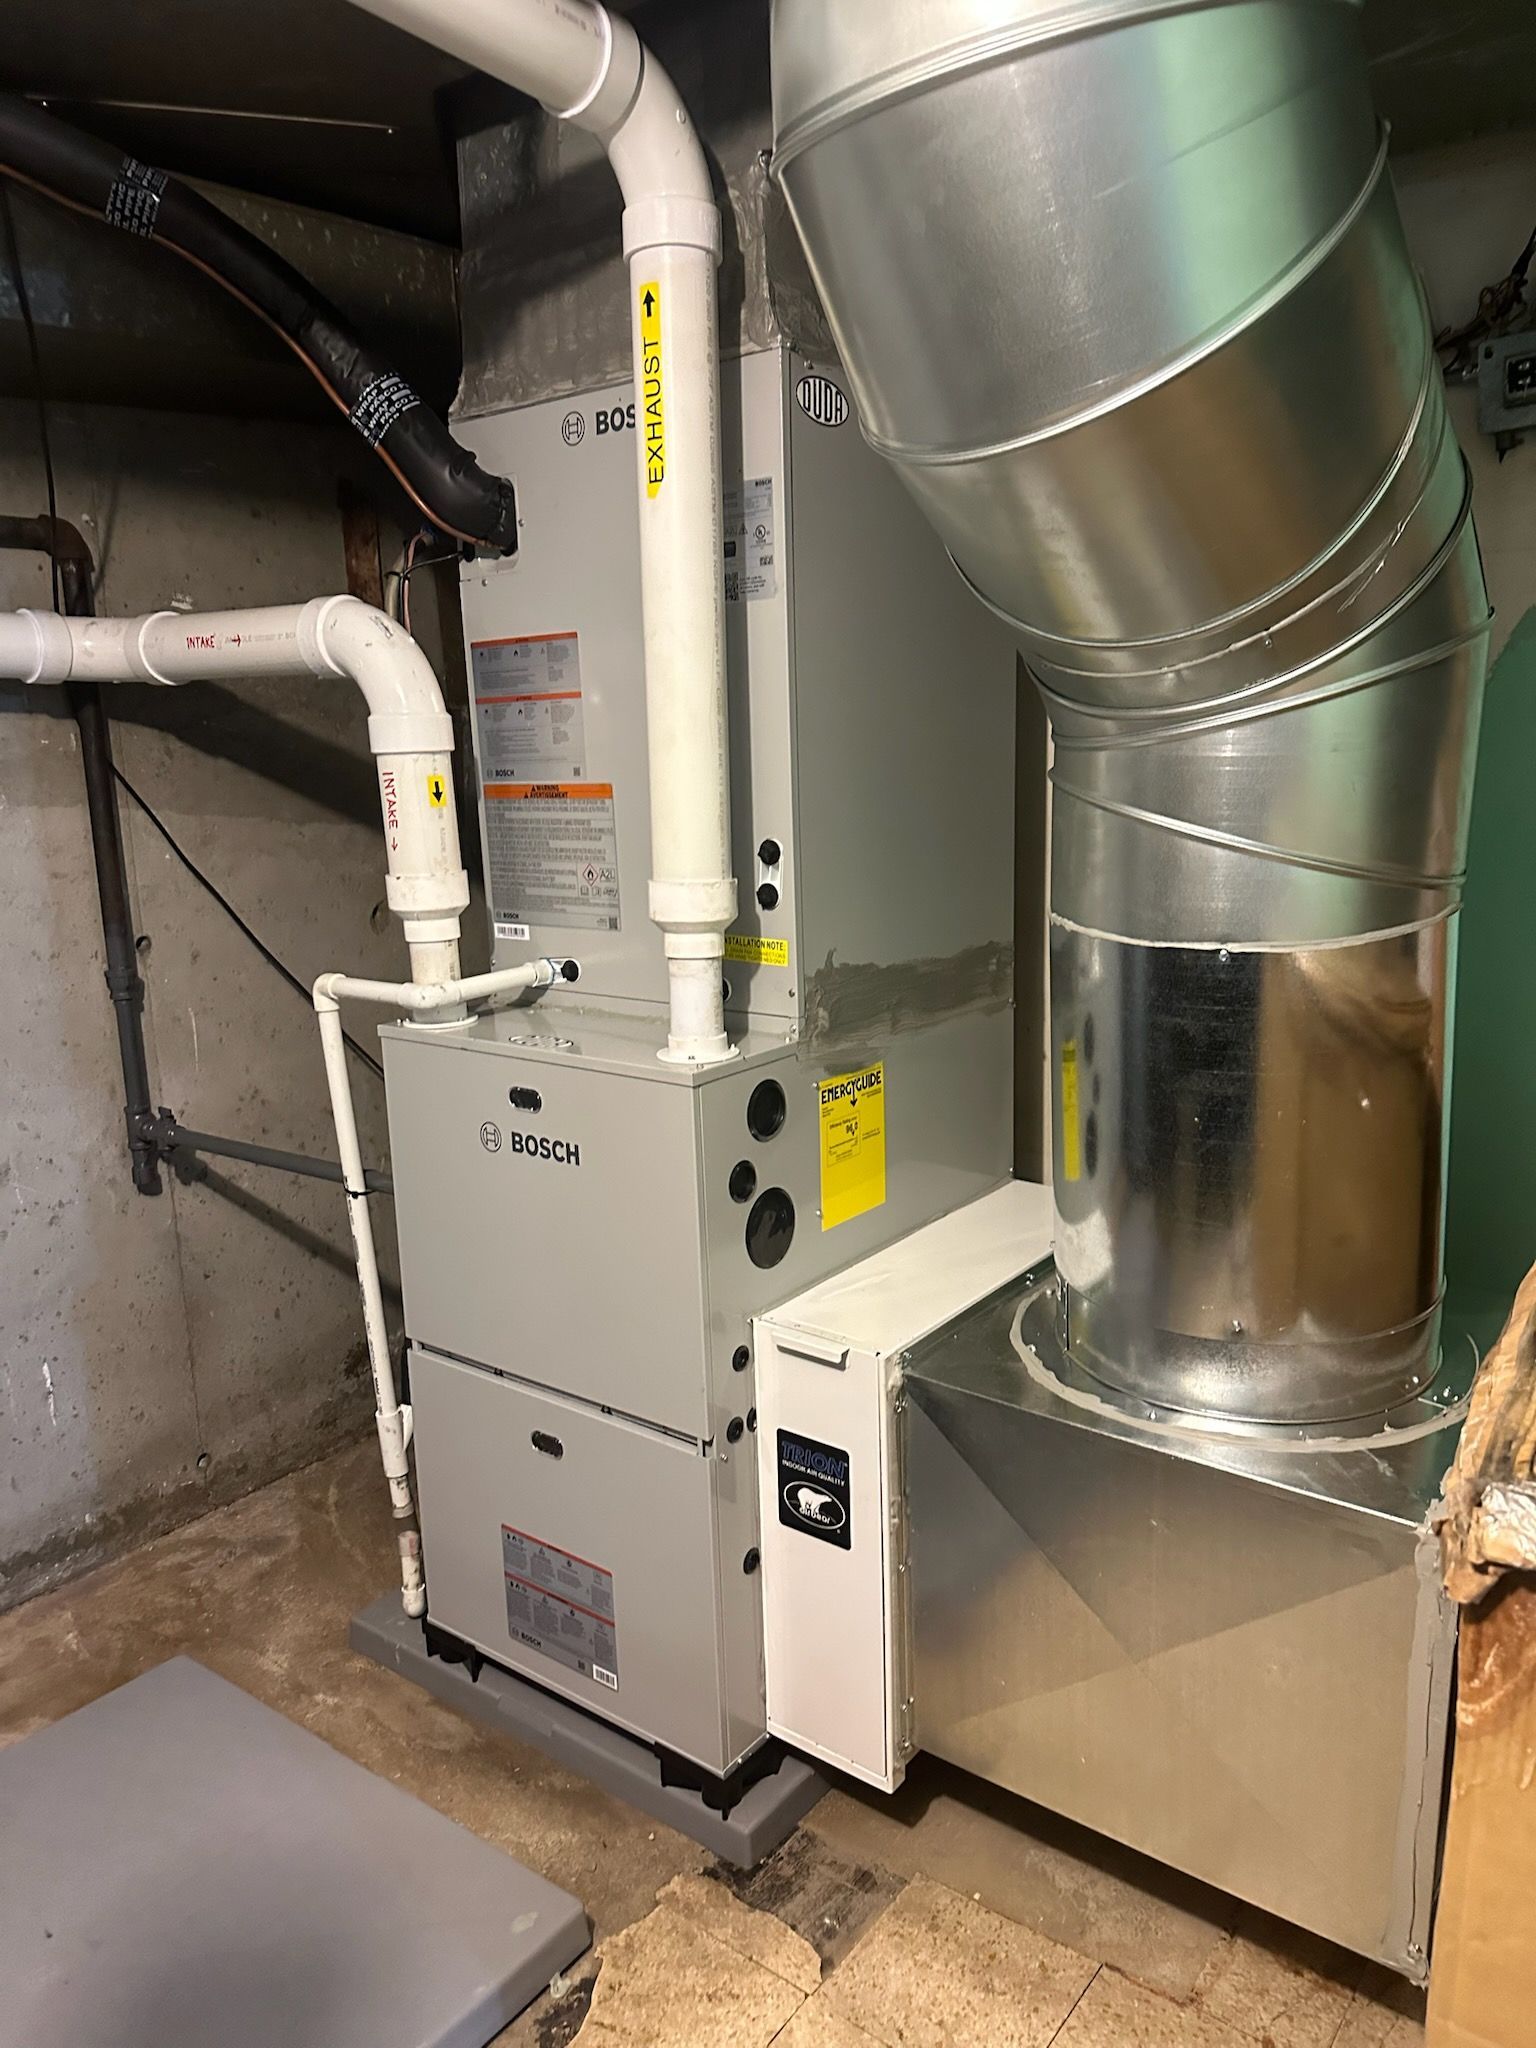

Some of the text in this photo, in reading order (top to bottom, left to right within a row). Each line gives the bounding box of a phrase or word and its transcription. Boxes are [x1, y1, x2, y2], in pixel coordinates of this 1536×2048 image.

[356, 388, 378, 417] WRAP
[643, 336, 665, 484] EXHAUST
[803, 379, 843, 423] DUDA
[596, 404, 636, 436] BOS
[186, 635, 215, 650] INTAKE
[495, 768, 515, 777] BOSCH
[382, 771, 398, 830] INTAKE
[725, 937, 766, 949] NSTALLATION
[821, 1070, 882, 1105] ENERGYGUIDE
[511, 1131, 580, 1167] BOSCH
[781, 1441, 846, 1479] TRION
[782, 1459, 846, 1487] INDOOR AIR QUALITY
[521, 1632, 542, 1648] BOSCH
